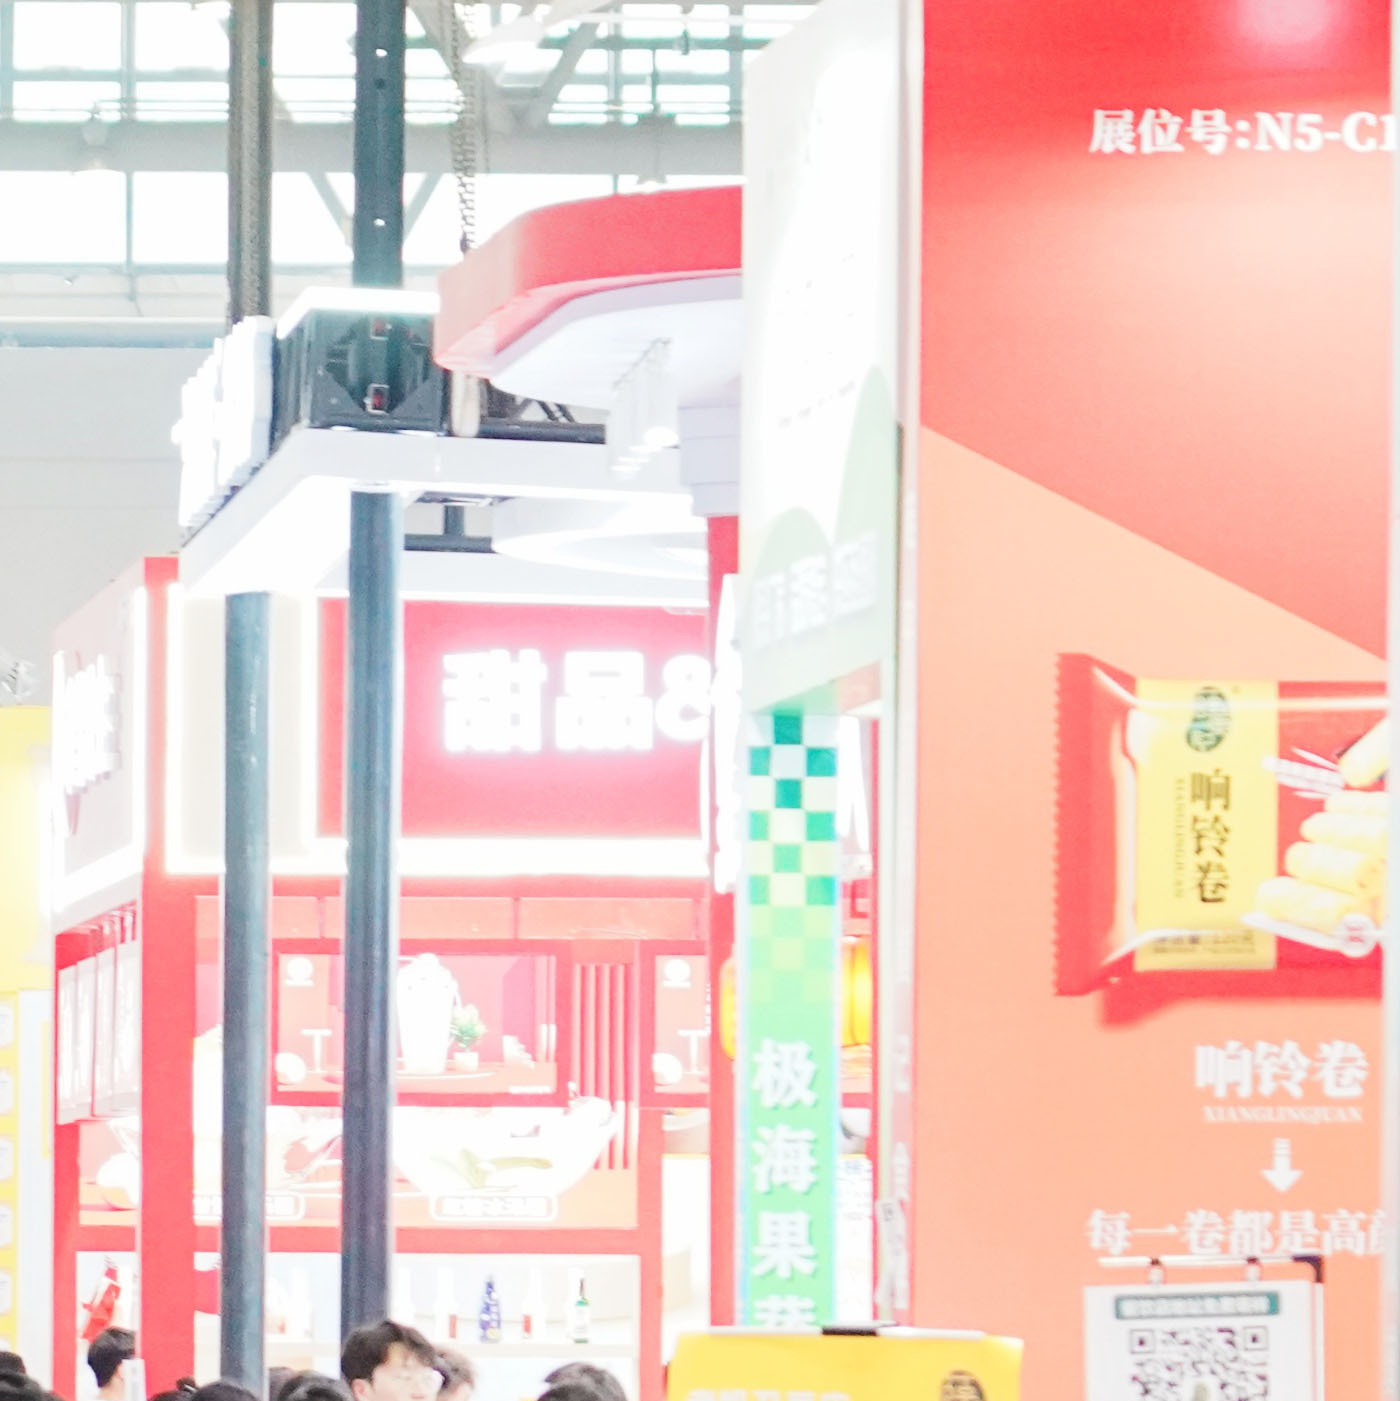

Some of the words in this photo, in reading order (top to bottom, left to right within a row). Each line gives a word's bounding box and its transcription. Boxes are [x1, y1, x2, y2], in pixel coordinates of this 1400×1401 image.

[1190, 767, 1231, 904] 响铃卷
[1195, 1040, 1369, 1098] 响铃卷
